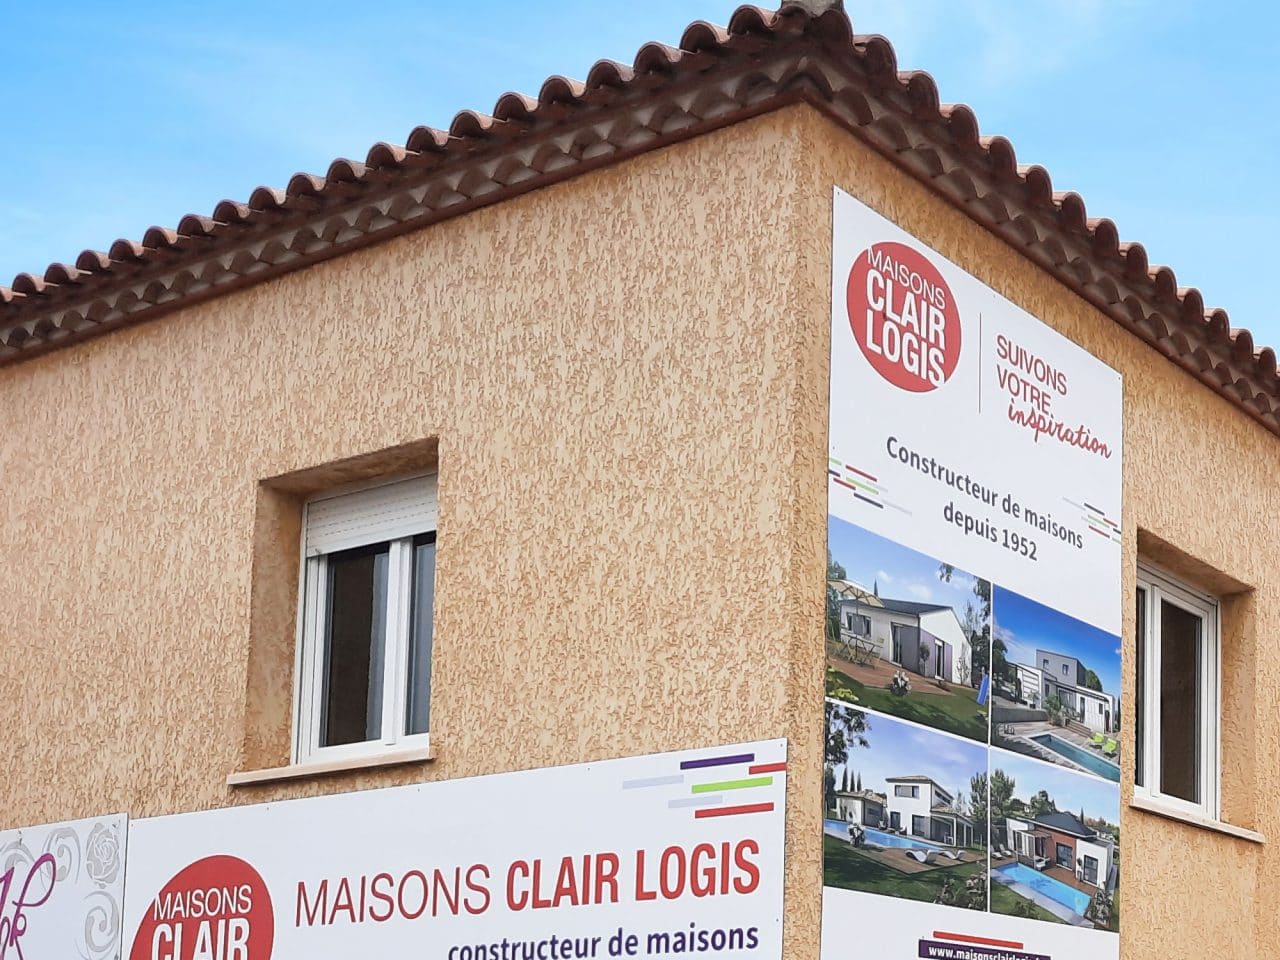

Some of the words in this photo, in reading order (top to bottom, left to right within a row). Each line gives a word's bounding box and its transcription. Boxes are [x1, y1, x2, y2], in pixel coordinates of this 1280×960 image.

[866, 247, 946, 310] MAISONS
[866, 269, 946, 350] CLAIR
[866, 309, 946, 388] LOGIS
[997, 334, 1067, 395] SUIVONS
[997, 363, 1051, 415] VOTRE
[1007, 398, 1112, 459] inspiration
[886, 436, 998, 507] Constructeur
[1002, 494, 1020, 518] de
[1024, 507, 1083, 549] maisons
[943, 501, 998, 543] depuis
[1002, 529, 1038, 561] 1952
[153, 884, 252, 921] MAISONS
[294, 863, 492, 928] MAISONS
[505, 852, 619, 912] CLAIR
[634, 838, 761, 901] LOGIS
[607, 927, 639, 957] de
[645, 922, 760, 955] maisons
